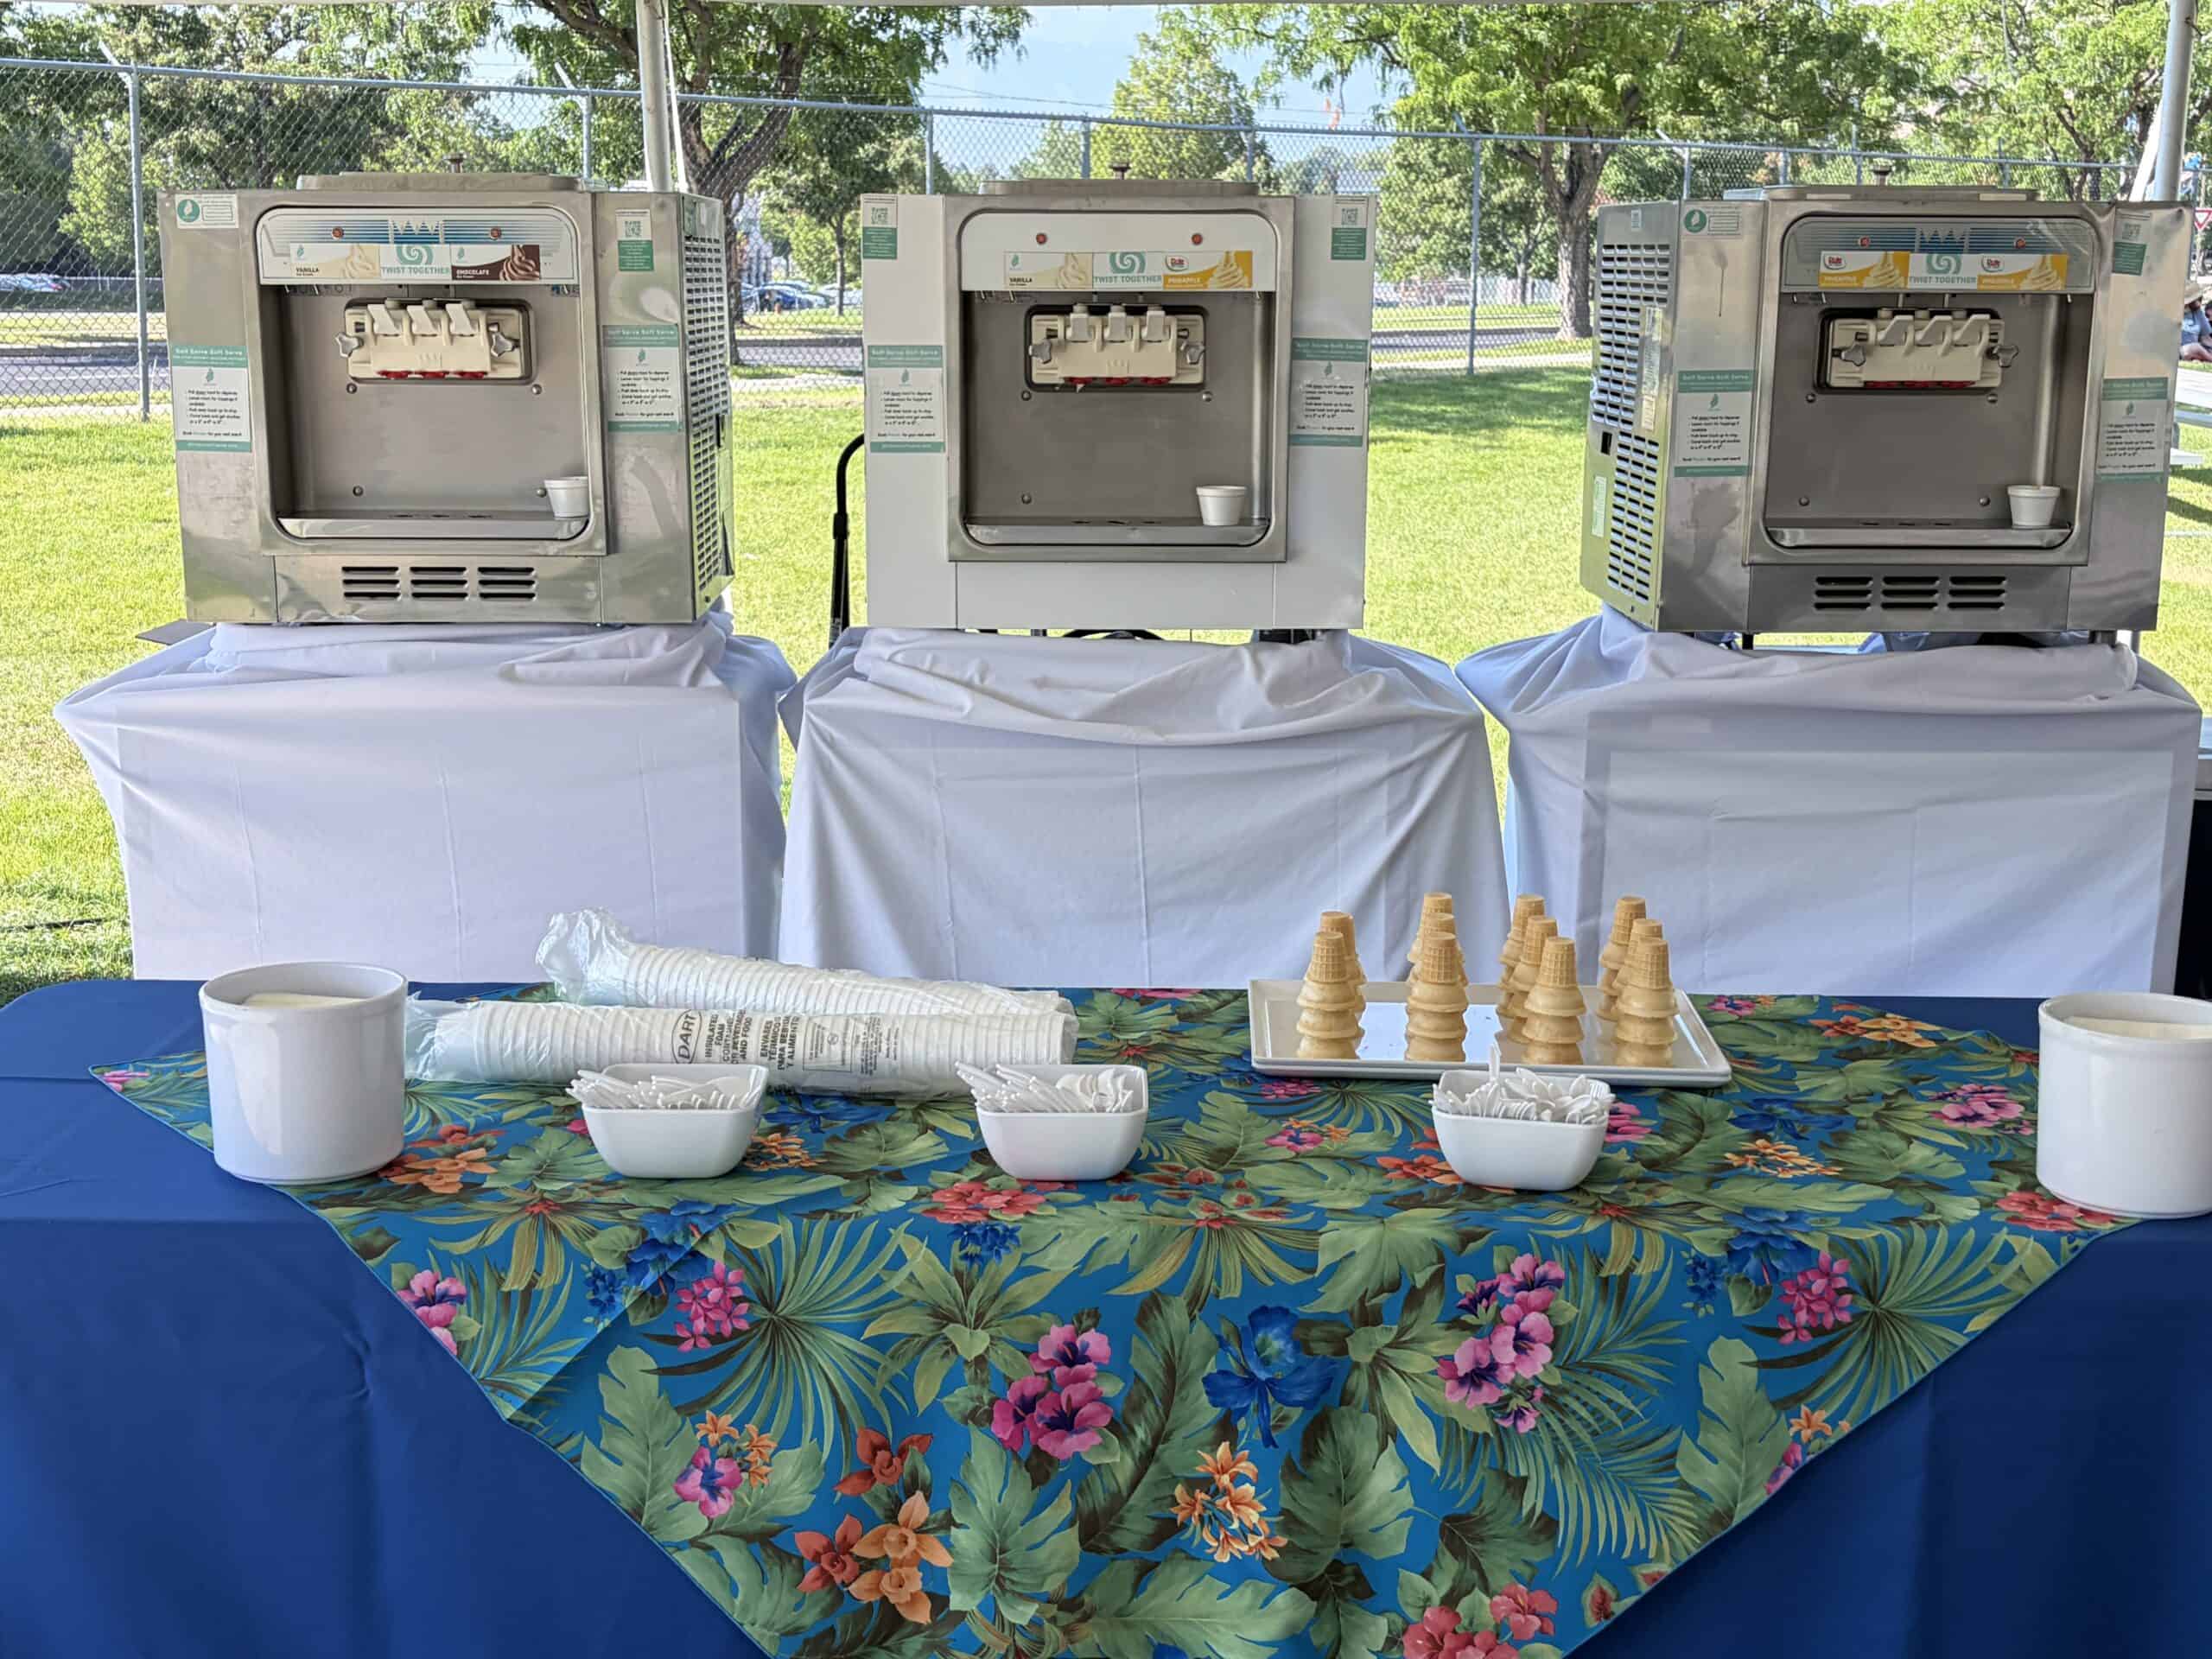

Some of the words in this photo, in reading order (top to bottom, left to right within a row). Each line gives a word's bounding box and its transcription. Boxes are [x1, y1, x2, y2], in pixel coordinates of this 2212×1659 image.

[381, 266, 405, 275] TWIST
[409, 266, 450, 275] TOGETHER
[1094, 276, 1118, 284] TWIST
[1121, 275, 1162, 284] TOGETHER
[1909, 276, 1932, 284] TWIST
[1936, 276, 1978, 284] TOGETHER
[677, 1014, 697, 1060] DART
[705, 1013, 719, 1058] INSULATED
[715, 1023, 725, 1046] FOAM
[743, 1017, 753, 1039] FOOD
[760, 1020, 773, 1058] ENVASES
